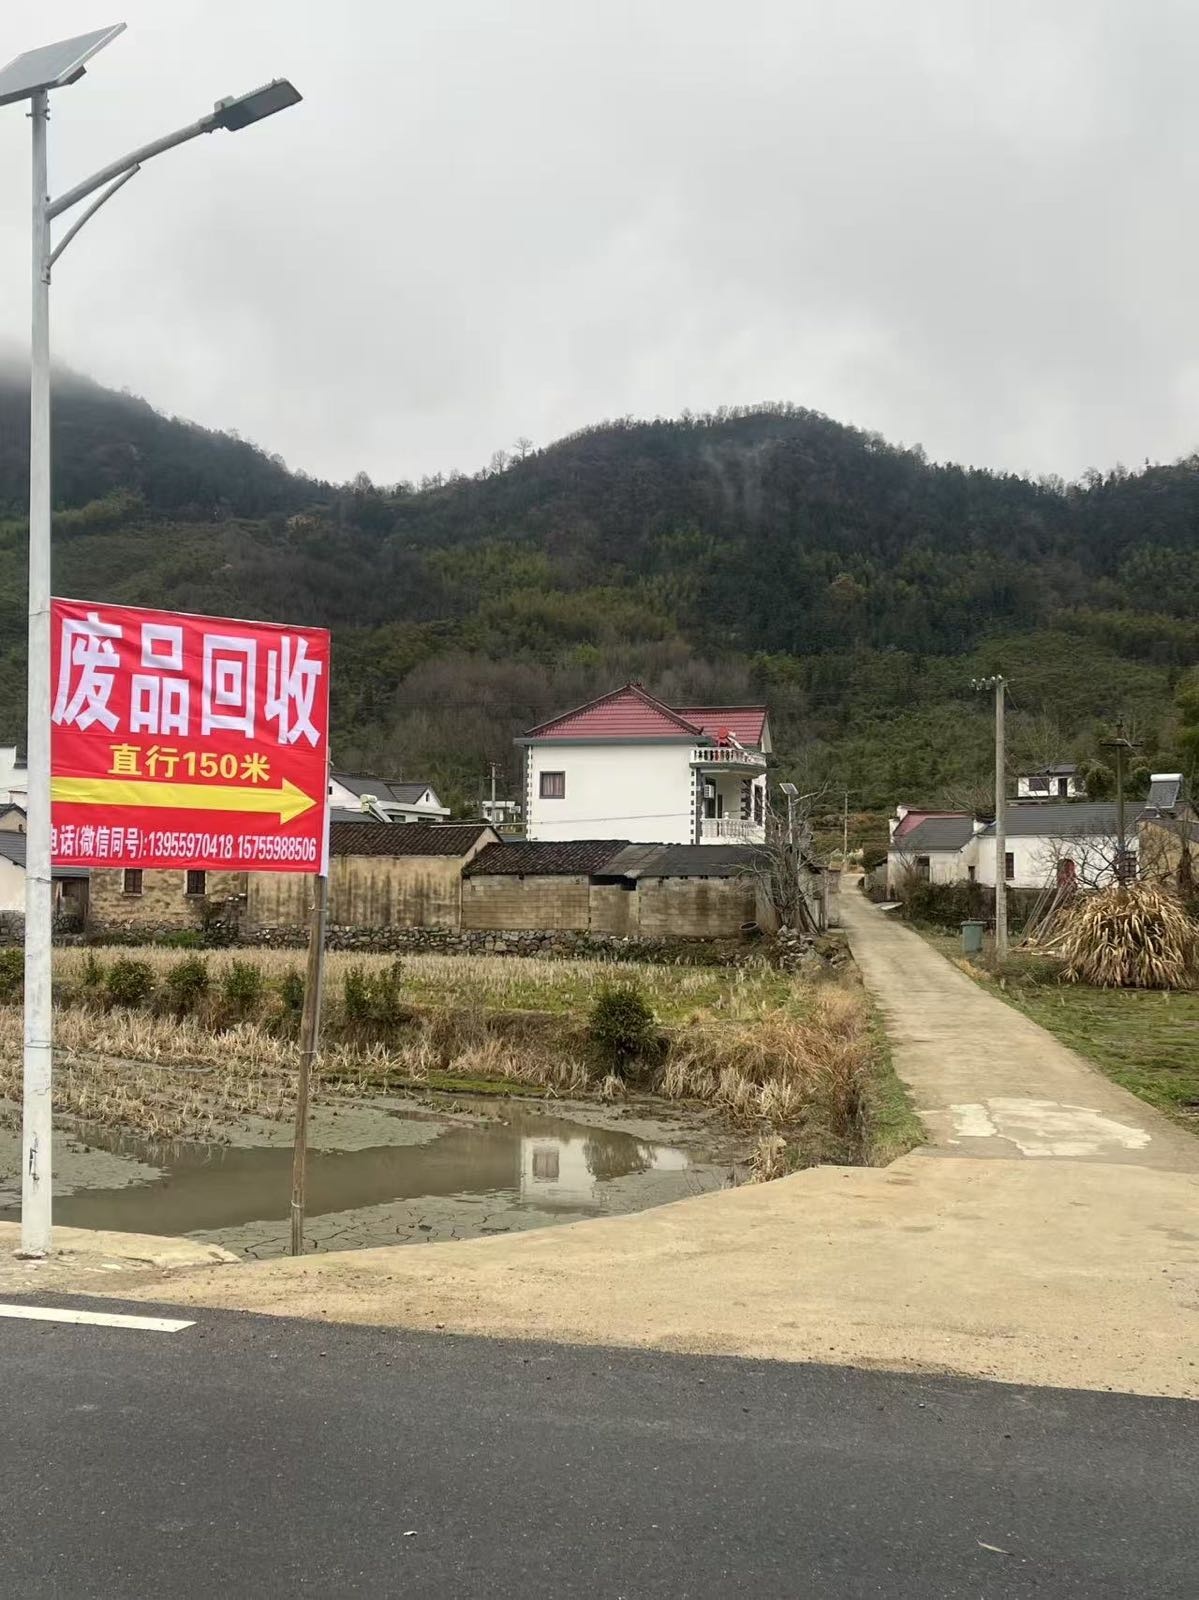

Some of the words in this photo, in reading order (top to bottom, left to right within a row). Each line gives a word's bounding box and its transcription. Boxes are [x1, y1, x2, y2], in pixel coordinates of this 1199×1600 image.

[51, 612, 323, 748] 废品回收
[107, 743, 271, 783] 直行150米
[237, 835, 317, 861] 15755988506
